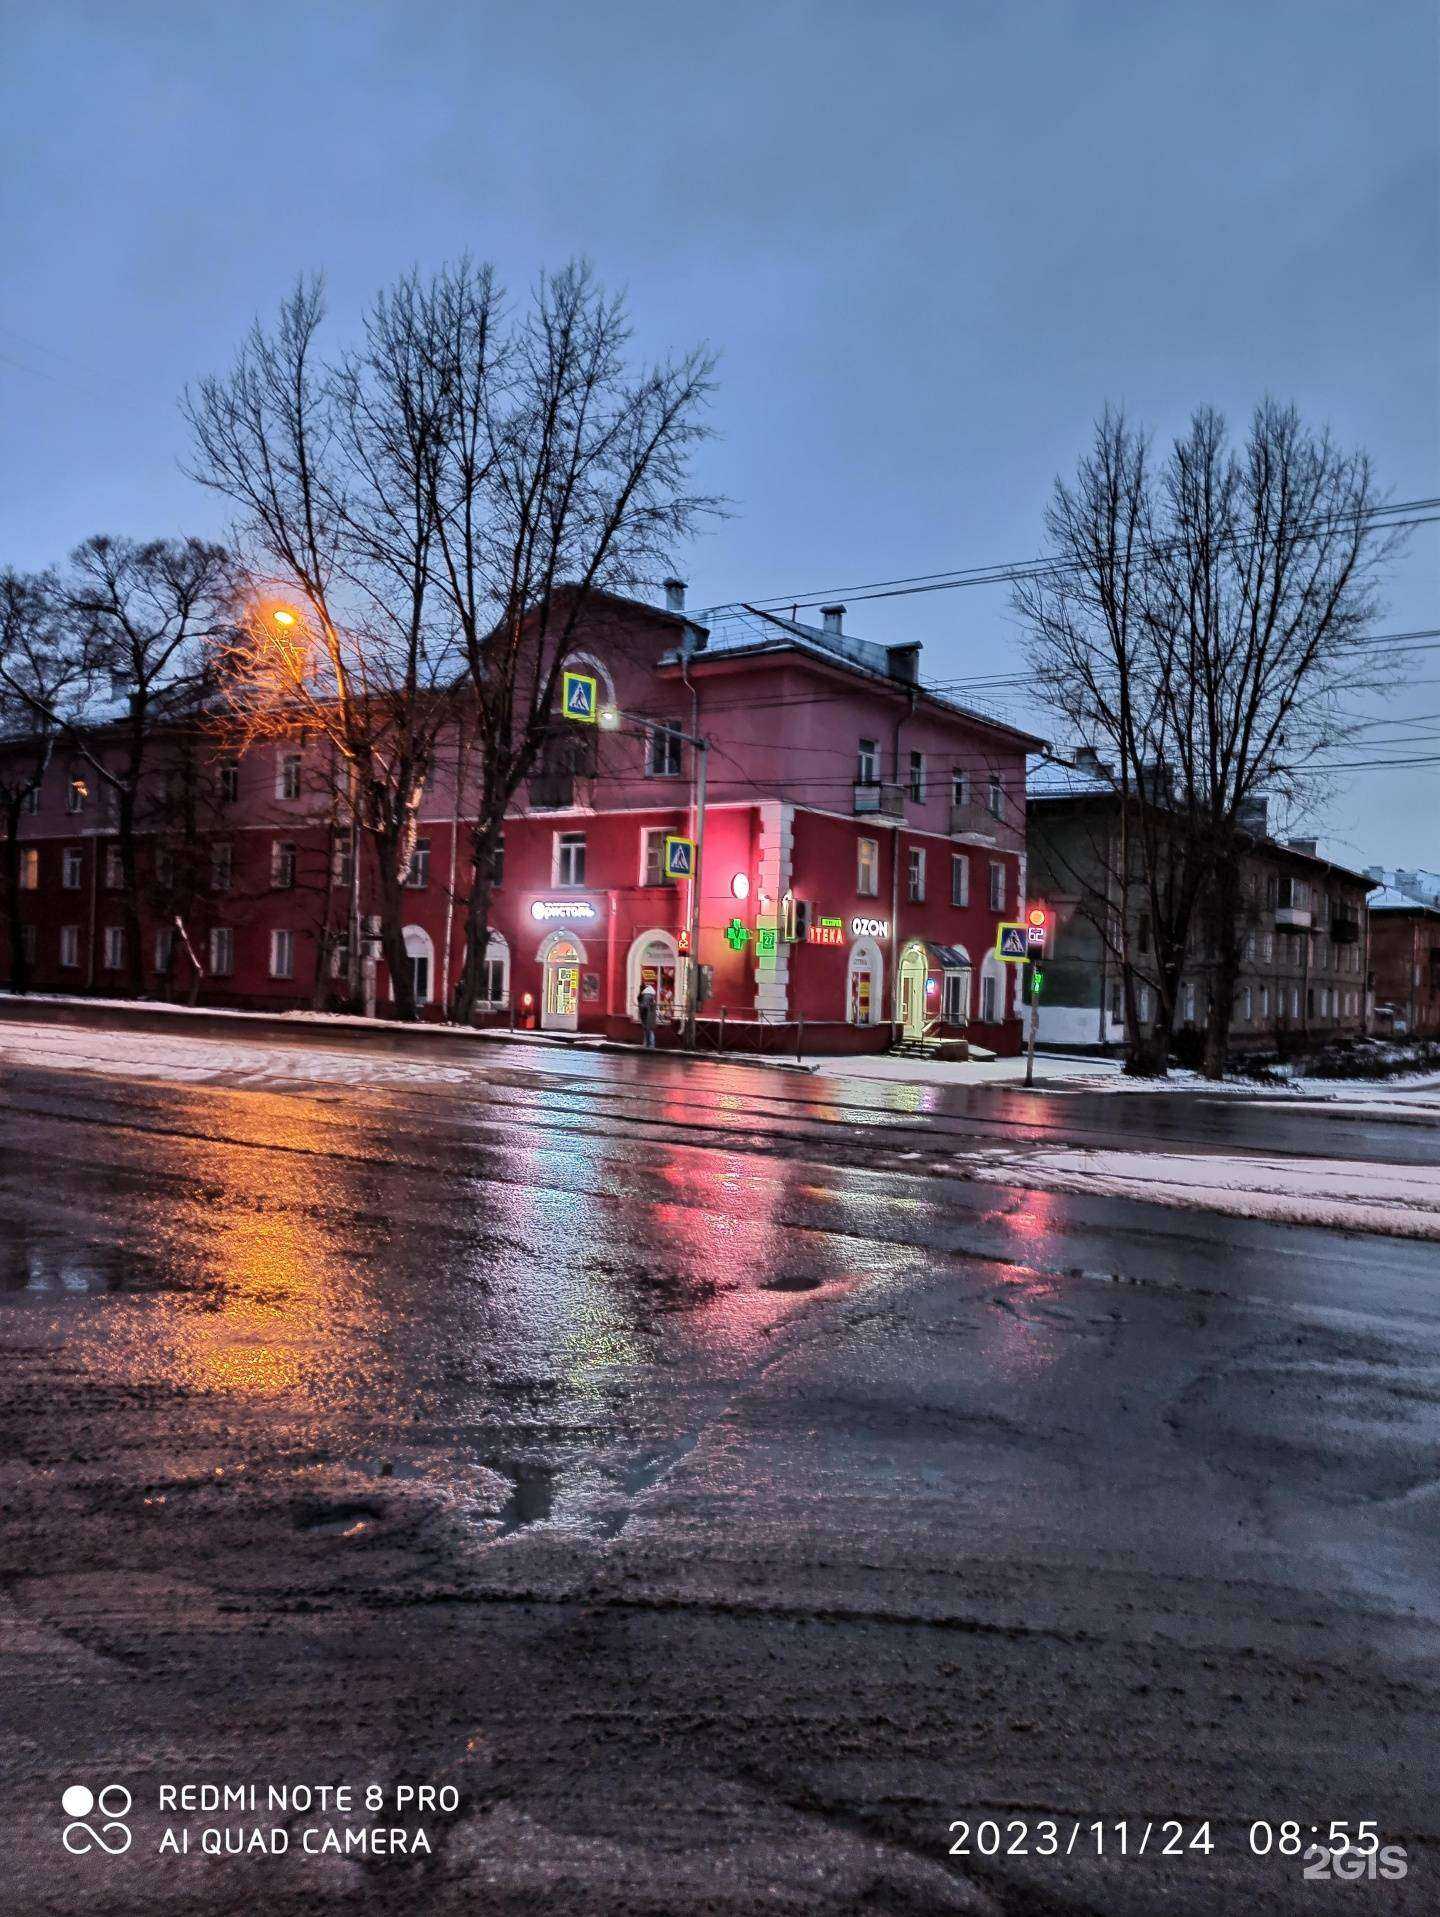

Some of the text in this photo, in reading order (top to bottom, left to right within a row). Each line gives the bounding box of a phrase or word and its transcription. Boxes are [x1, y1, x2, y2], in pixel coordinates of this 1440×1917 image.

[809, 927, 844, 945] ТЕКА
[852, 918, 889, 938] OZON
[1028, 927, 1045, 942] 62
